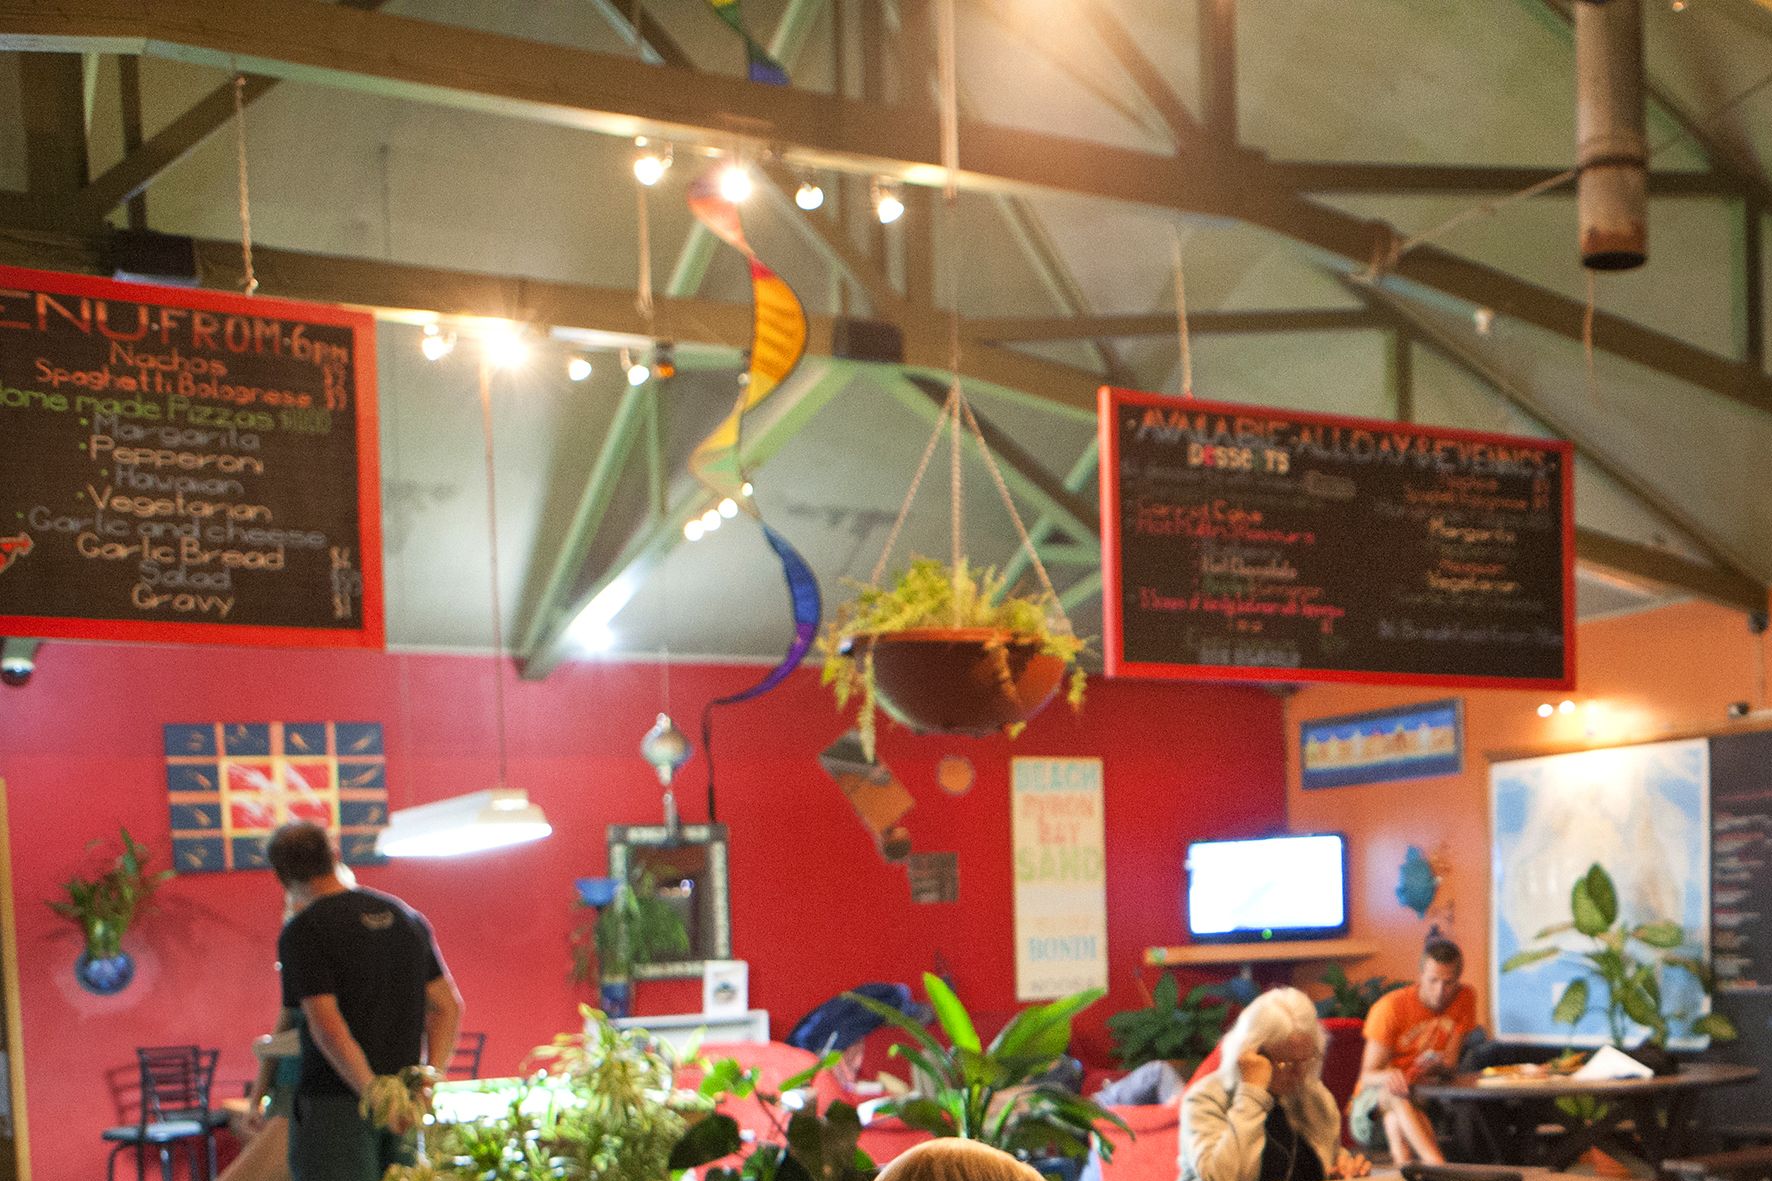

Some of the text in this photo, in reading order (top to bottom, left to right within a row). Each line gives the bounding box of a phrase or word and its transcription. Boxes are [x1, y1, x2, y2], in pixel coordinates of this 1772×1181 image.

[160, 308, 280, 353] FROM
[35, 357, 171, 393] Spaghetti
[110, 340, 228, 376] Nachos
[0, 380, 69, 412] ome
[76, 392, 162, 421] made
[167, 394, 275, 432] Pizzas
[28, 505, 130, 537] Garlic
[136, 514, 200, 540] and
[76, 532, 285, 571] Garlic Bread
[139, 560, 232, 590] Salad
[131, 582, 235, 618] Gravy
[1018, 846, 1100, 881] SAND
